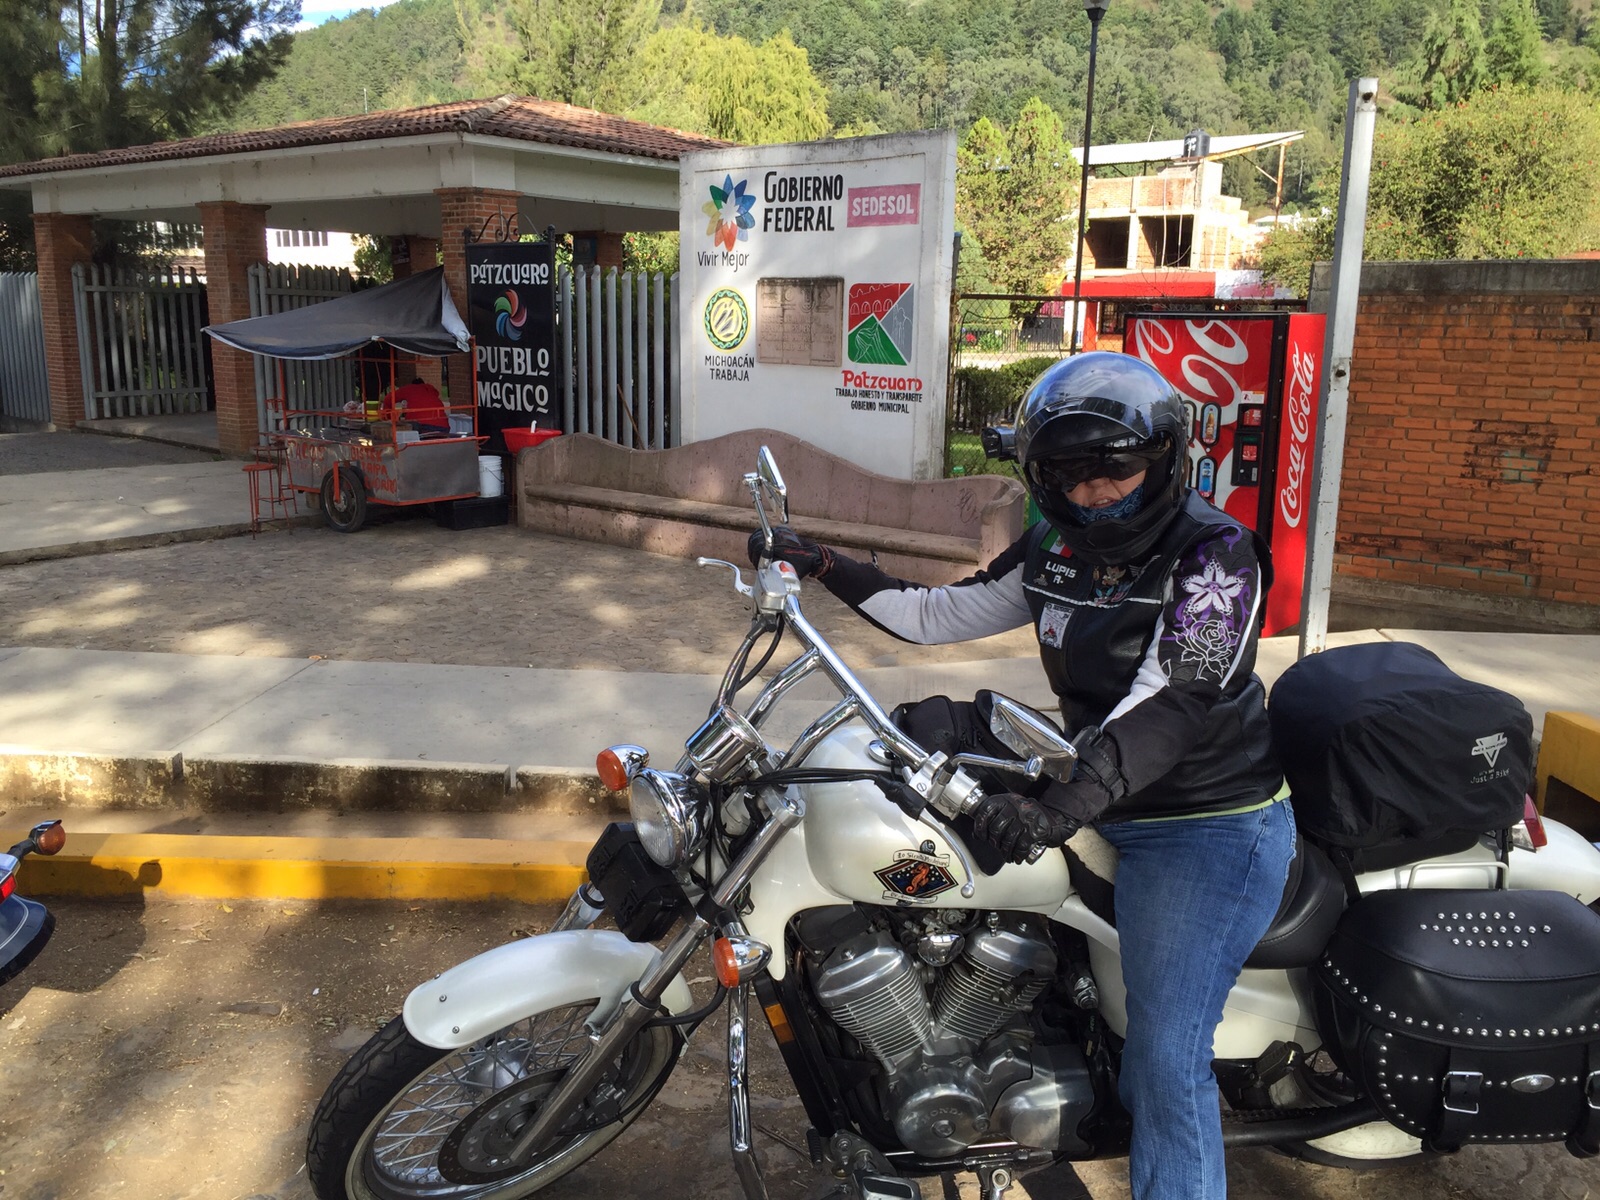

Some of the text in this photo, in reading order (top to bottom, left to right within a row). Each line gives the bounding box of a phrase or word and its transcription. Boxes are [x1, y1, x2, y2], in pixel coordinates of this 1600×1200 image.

[764, 171, 844, 203] GOBIERNO
[851, 194, 915, 217] SEDESOL
[763, 206, 835, 232] FEDERAL
[697, 252, 750, 272] Vivir Mejor
[476, 346, 550, 377] PUEBLO
[705, 353, 755, 369] MICHOACÁN
[709, 368, 750, 382] TRABAJA
[835, 388, 857, 398] TRABAJO
[858, 389, 880, 400] HONESTO
[851, 400, 910, 414] GOBIERNO MUNICIPAL
[1280, 341, 1315, 528] Coca-Cola
[1045, 561, 1077, 578] LUPIS
